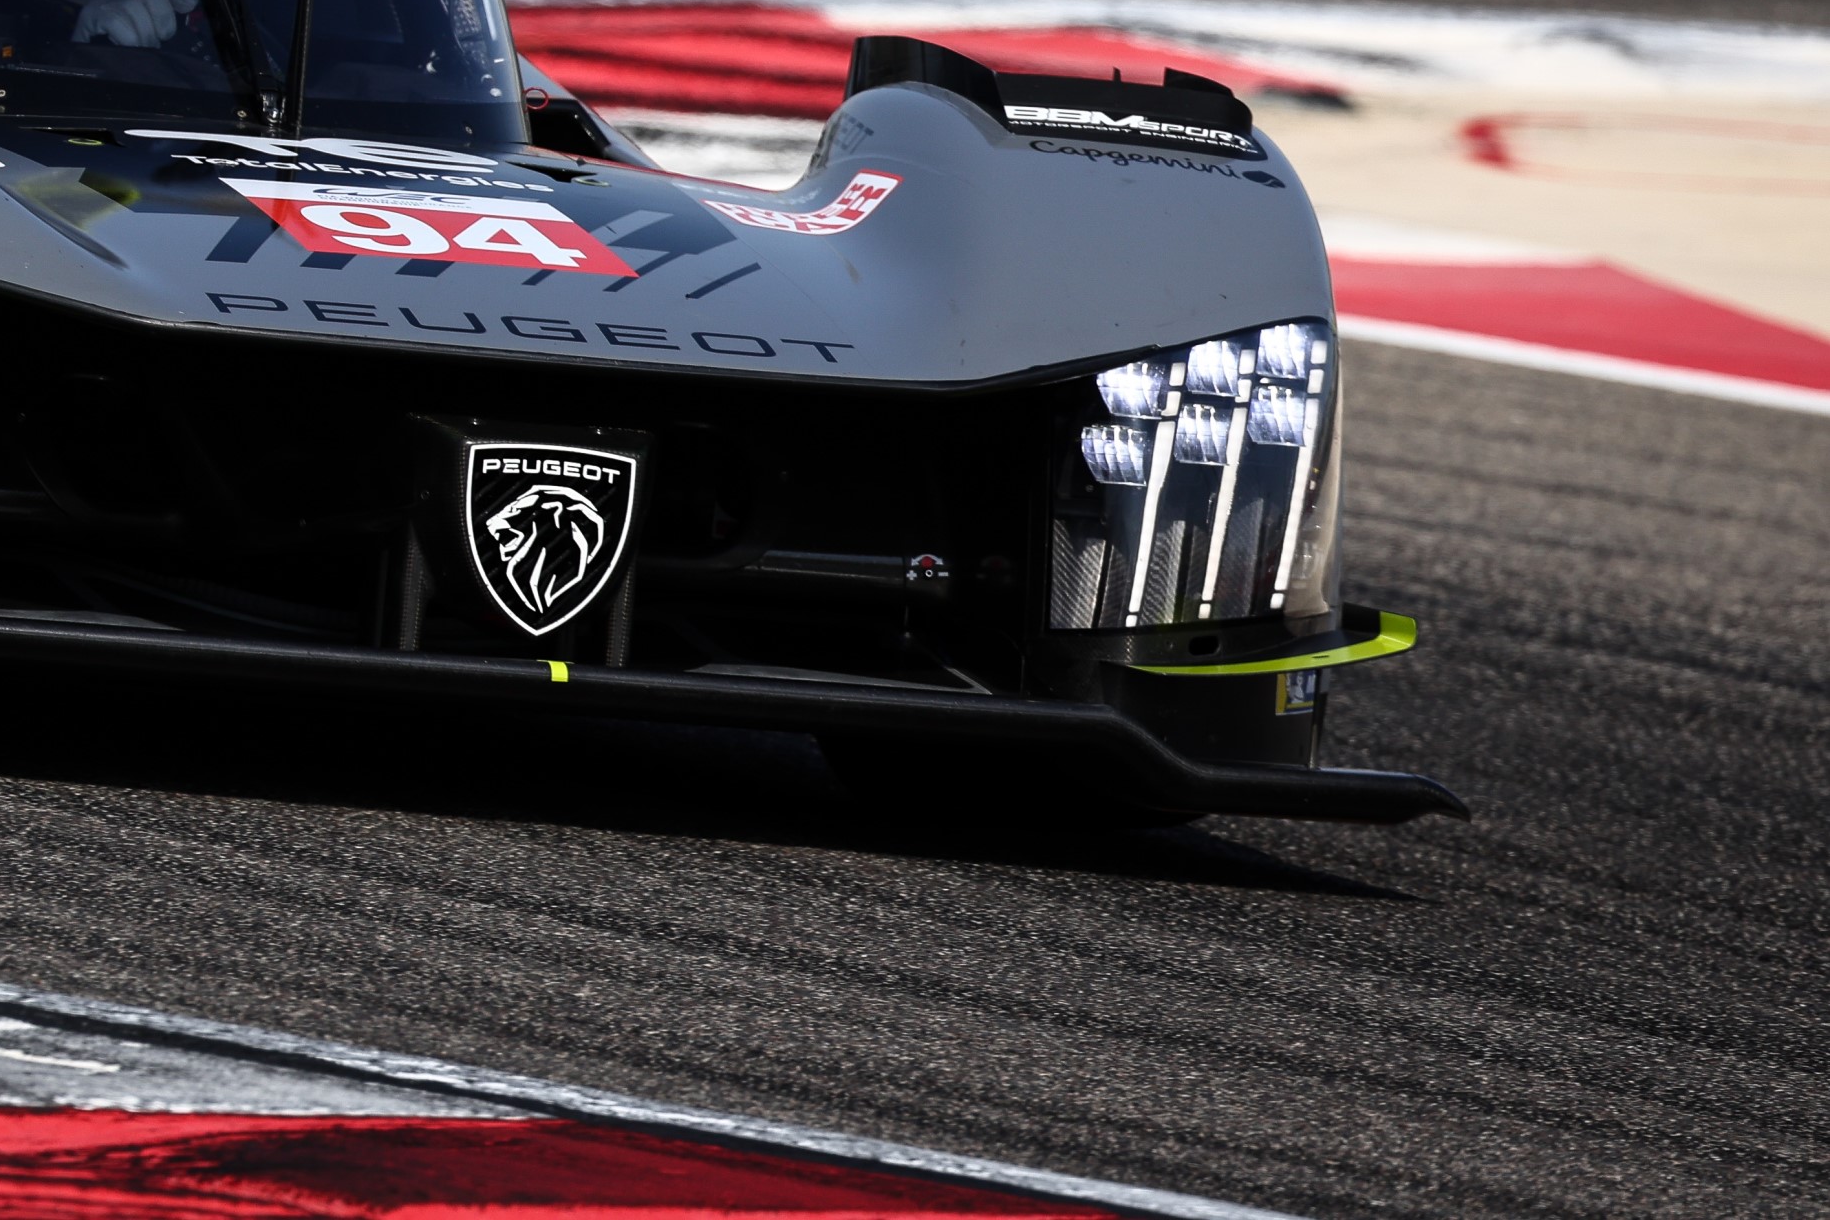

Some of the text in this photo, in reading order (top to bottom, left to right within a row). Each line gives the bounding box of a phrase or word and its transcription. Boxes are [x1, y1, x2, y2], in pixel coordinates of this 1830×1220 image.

[170, 154, 555, 193] TotalEnergies
[1030, 140, 1242, 180] Capgemini
[300, 204, 588, 268] 94
[204, 291, 854, 363] PEUGEOT
[482, 458, 621, 484] PEUGEOT
